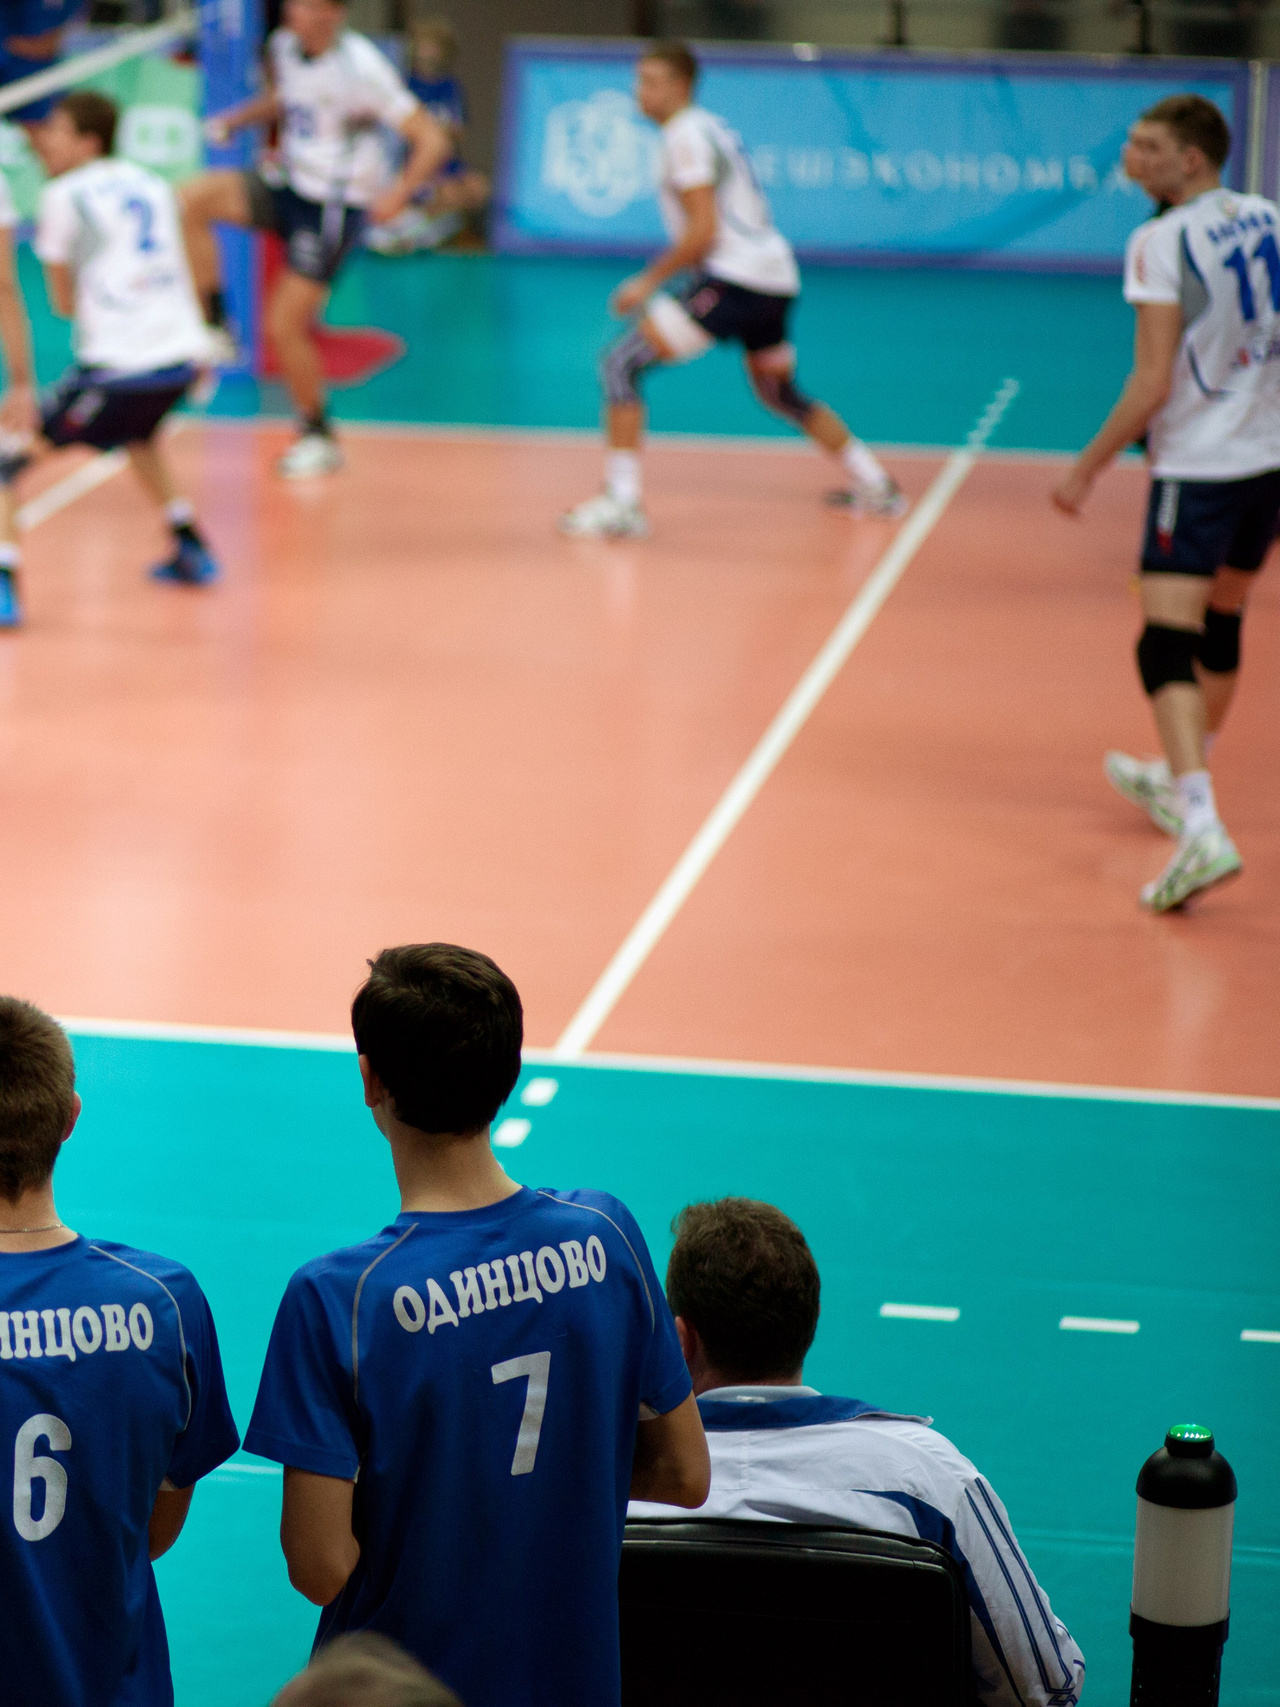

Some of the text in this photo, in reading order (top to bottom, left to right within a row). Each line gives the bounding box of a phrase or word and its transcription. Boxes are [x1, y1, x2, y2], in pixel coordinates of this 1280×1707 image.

[122, 196, 161, 252] 2
[1223, 229, 1280, 322] 11
[393, 1235, 607, 1335] ОДИНЦОВО
[491, 1350, 551, 1476] 7
[13, 1413, 72, 1542] 6
